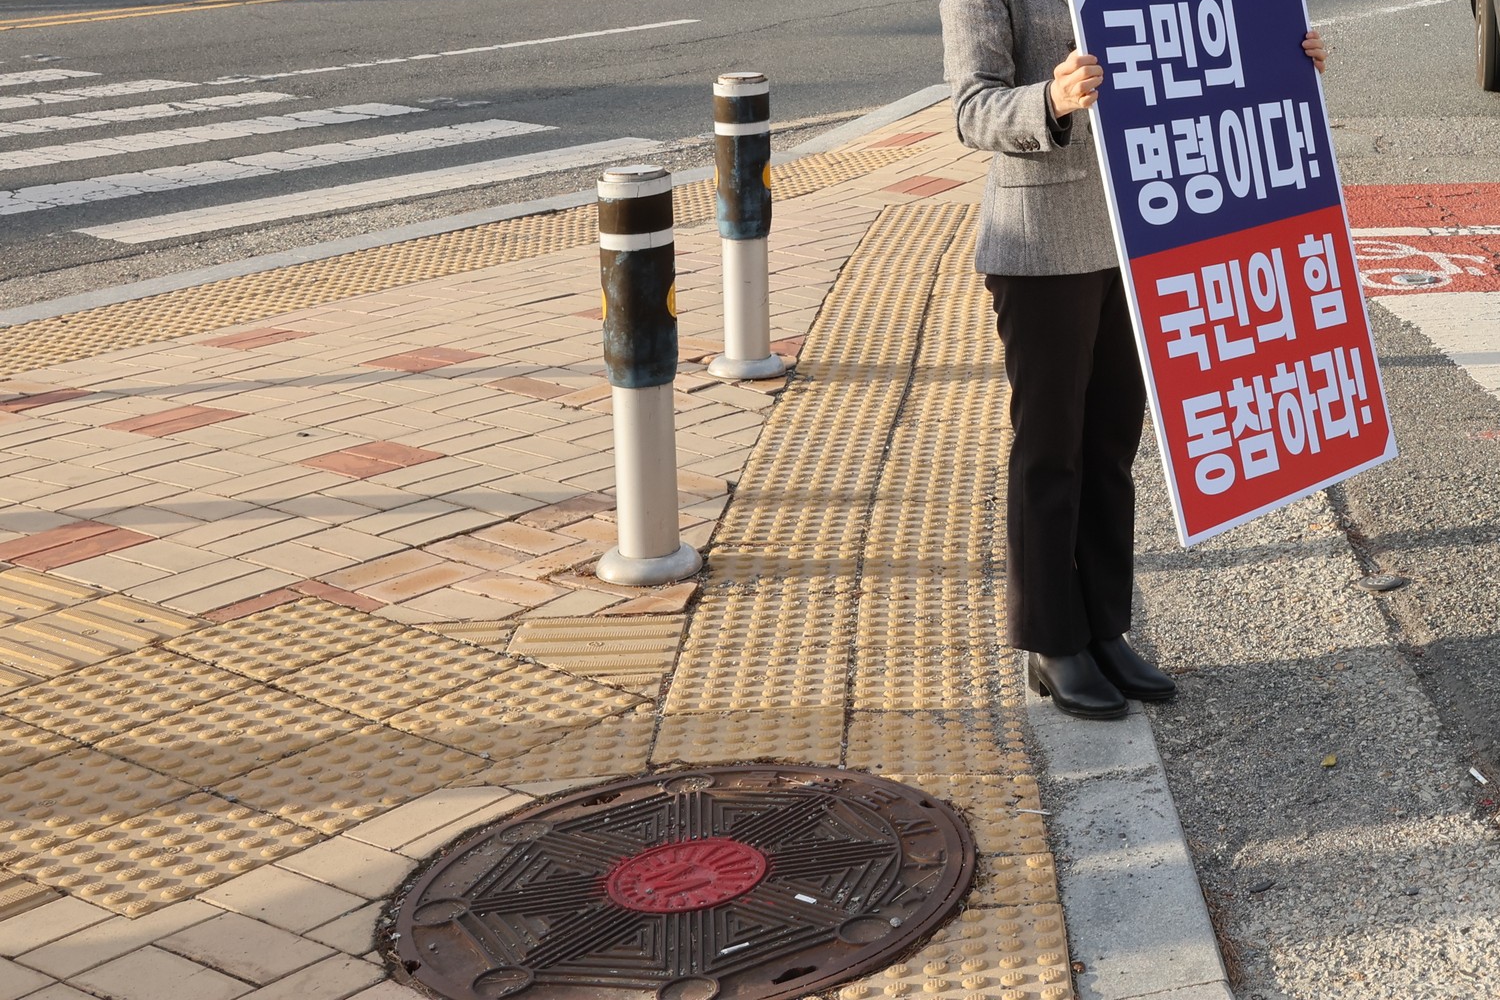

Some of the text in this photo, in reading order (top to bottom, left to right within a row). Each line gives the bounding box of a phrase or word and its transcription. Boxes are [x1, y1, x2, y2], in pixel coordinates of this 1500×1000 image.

[1123, 98, 1321, 226] 명령이다!
[1155, 233, 1348, 371] 국민의 힘
[1182, 347, 1373, 496] 동참하라!
